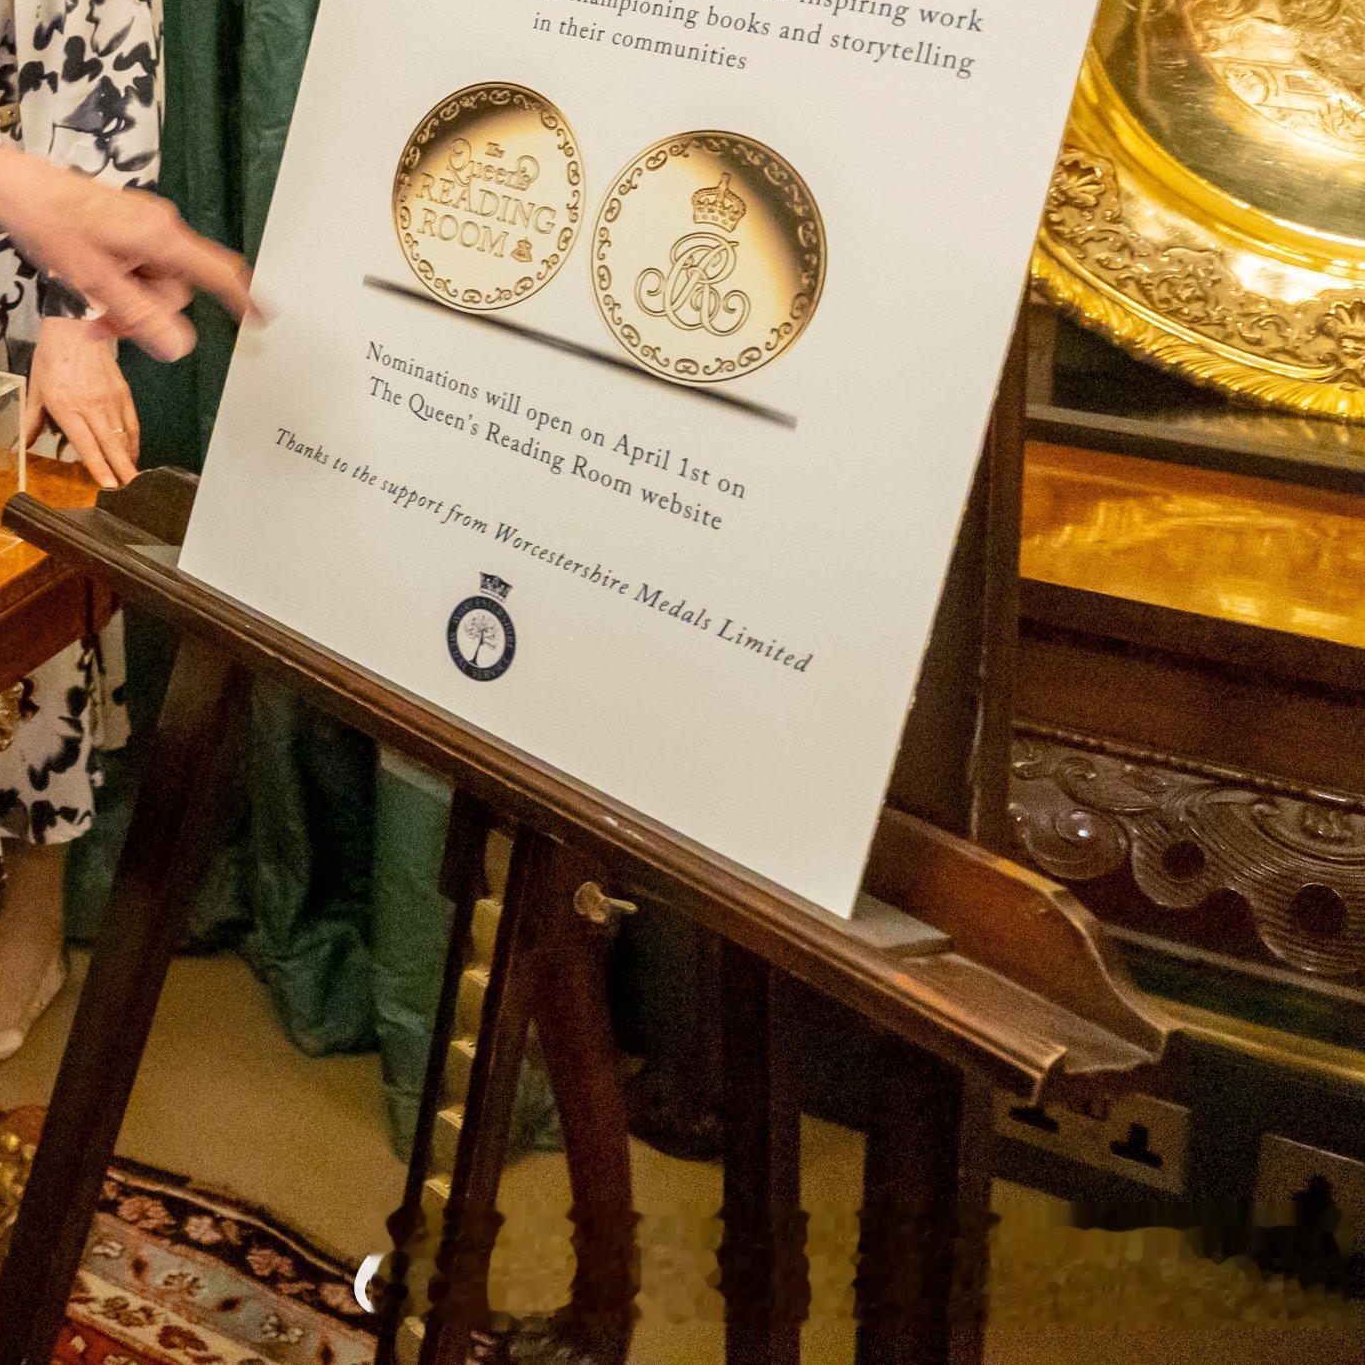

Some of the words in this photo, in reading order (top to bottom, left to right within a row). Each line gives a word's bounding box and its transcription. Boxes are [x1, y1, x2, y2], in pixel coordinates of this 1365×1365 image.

[533, 12, 551, 32] in
[559, 17, 606, 41] their
[612, 33, 747, 69] communities
[707, 5, 770, 35] books
[779, 23, 822, 44] and
[830, 35, 975, 79] storytelling
[920, 8, 983, 32] work
[485, 142, 505, 159] The
[416, 172, 557, 235] READING
[417, 207, 509, 258] ROOM
[366, 341, 478, 399] Nominations
[486, 391, 521, 415] will
[526, 408, 572, 435] open
[580, 428, 604, 447] on
[612, 434, 670, 470] April
[678, 458, 710, 485] 1st
[718, 479, 745, 499] on
[370, 376, 402, 405] The
[409, 393, 478, 435] Queen's
[485, 422, 565, 475] Reading
[571, 455, 631, 496] Room
[641, 488, 722, 530] website
[276, 428, 329, 464] Thanks
[332, 458, 348, 472] to
[352, 465, 377, 485] the
[380, 480, 443, 509] support
[441, 504, 488, 534] from
[495, 522, 629, 595] Worcestershire
[633, 583, 711, 630] Medals
[716, 619, 813, 672] Limited
